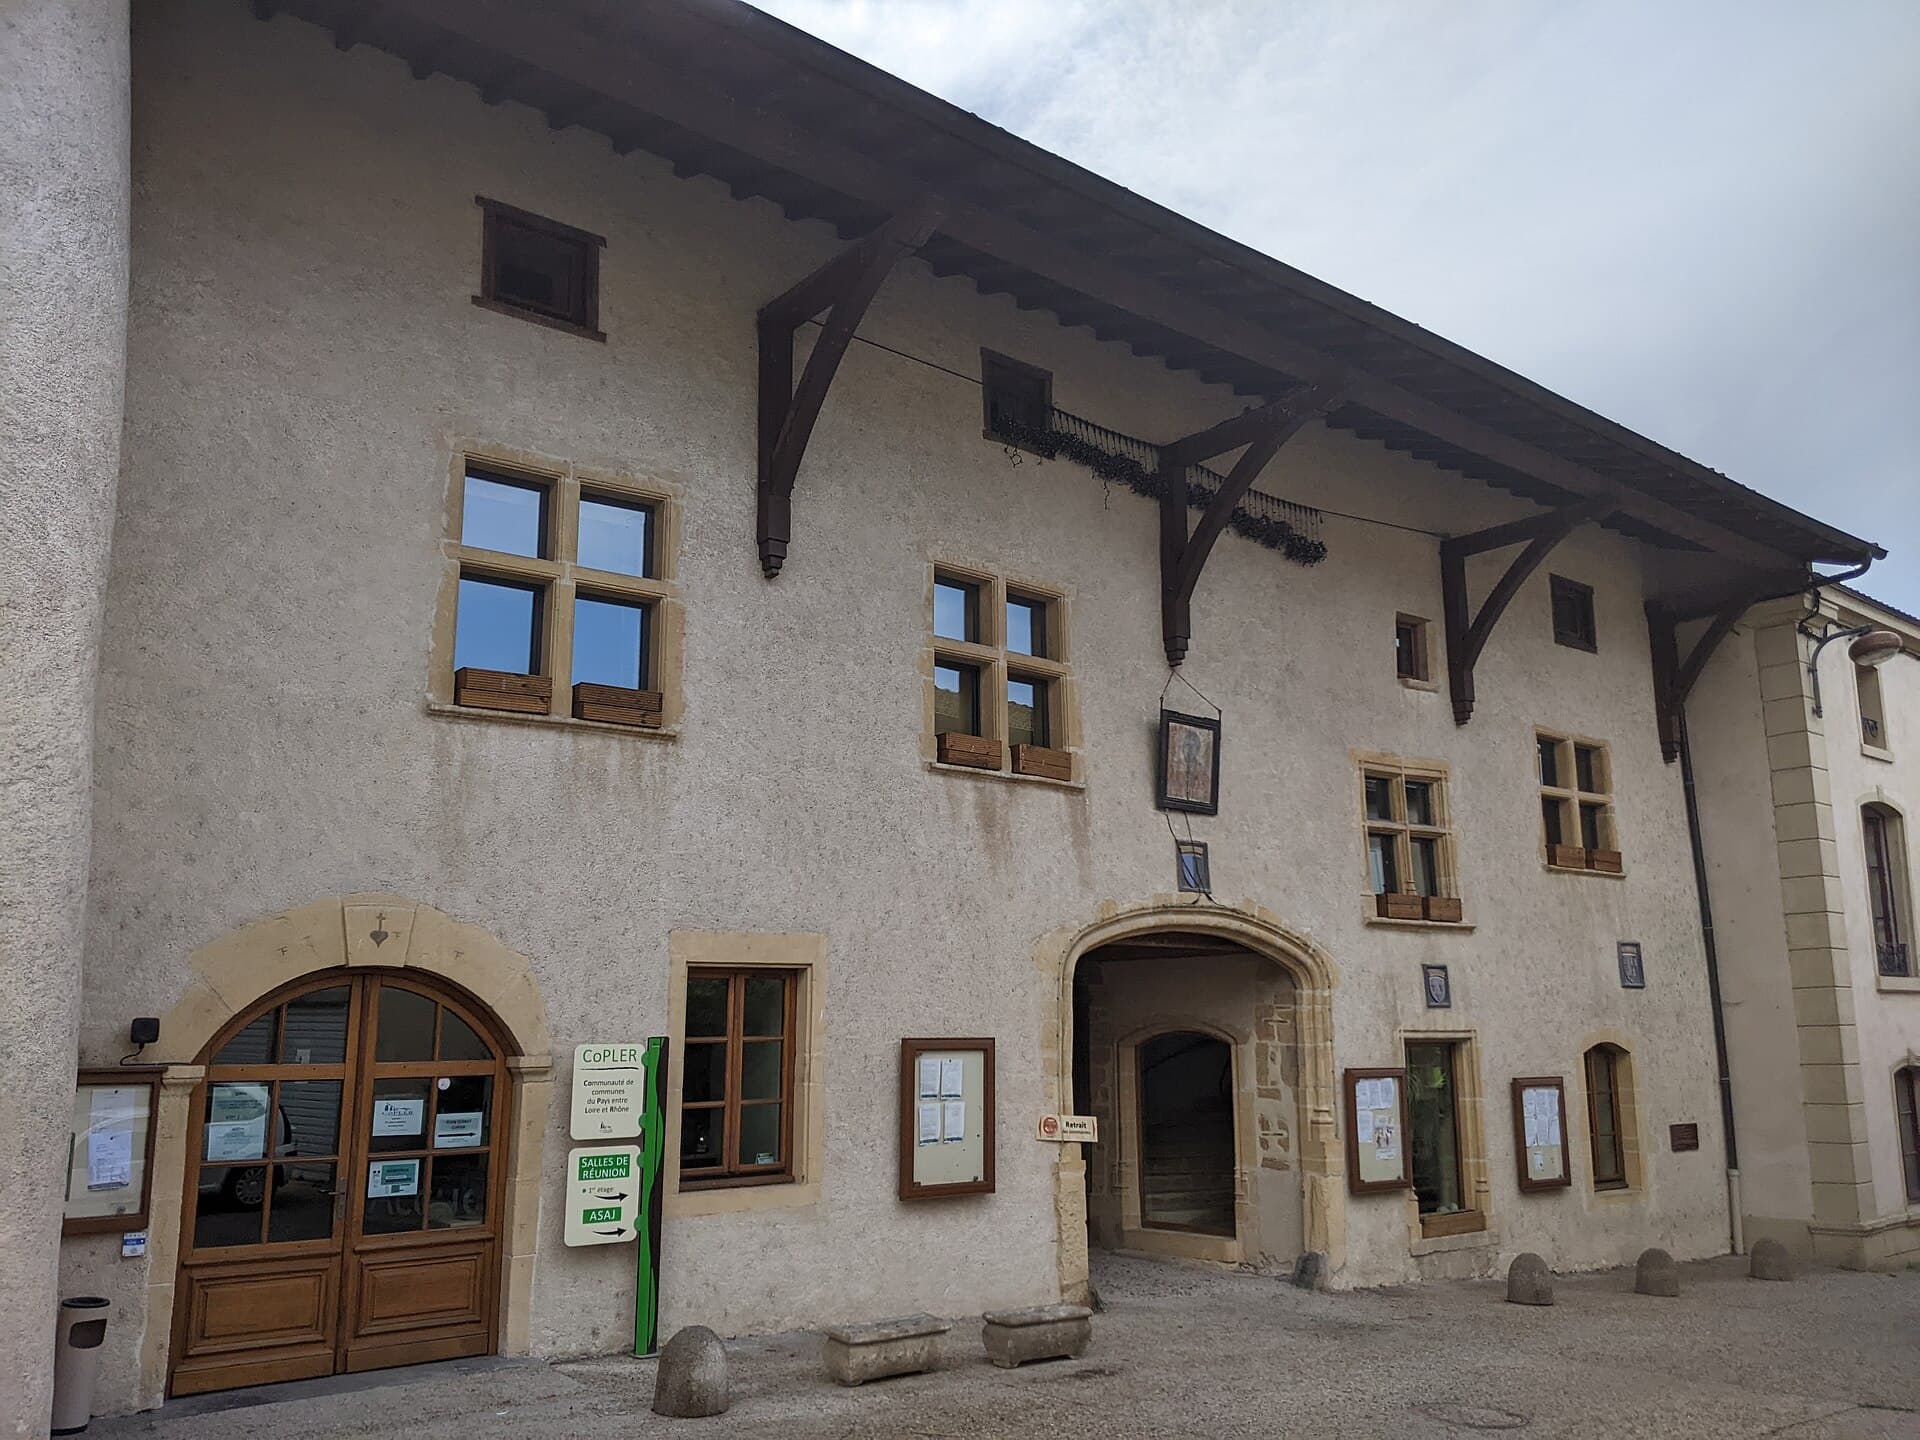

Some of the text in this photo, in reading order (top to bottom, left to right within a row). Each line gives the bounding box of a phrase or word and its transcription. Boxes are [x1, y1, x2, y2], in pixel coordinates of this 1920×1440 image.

[582, 1048, 637, 1063] CoPLER
[583, 1078, 634, 1087] Communauté de
[596, 1097, 610, 1105] Pays
[1065, 1120, 1087, 1129] Retrait
[581, 1156, 629, 1168] SALLES DE
[583, 1168, 626, 1179] RÉUNION
[589, 1210, 617, 1223] ASAJ
